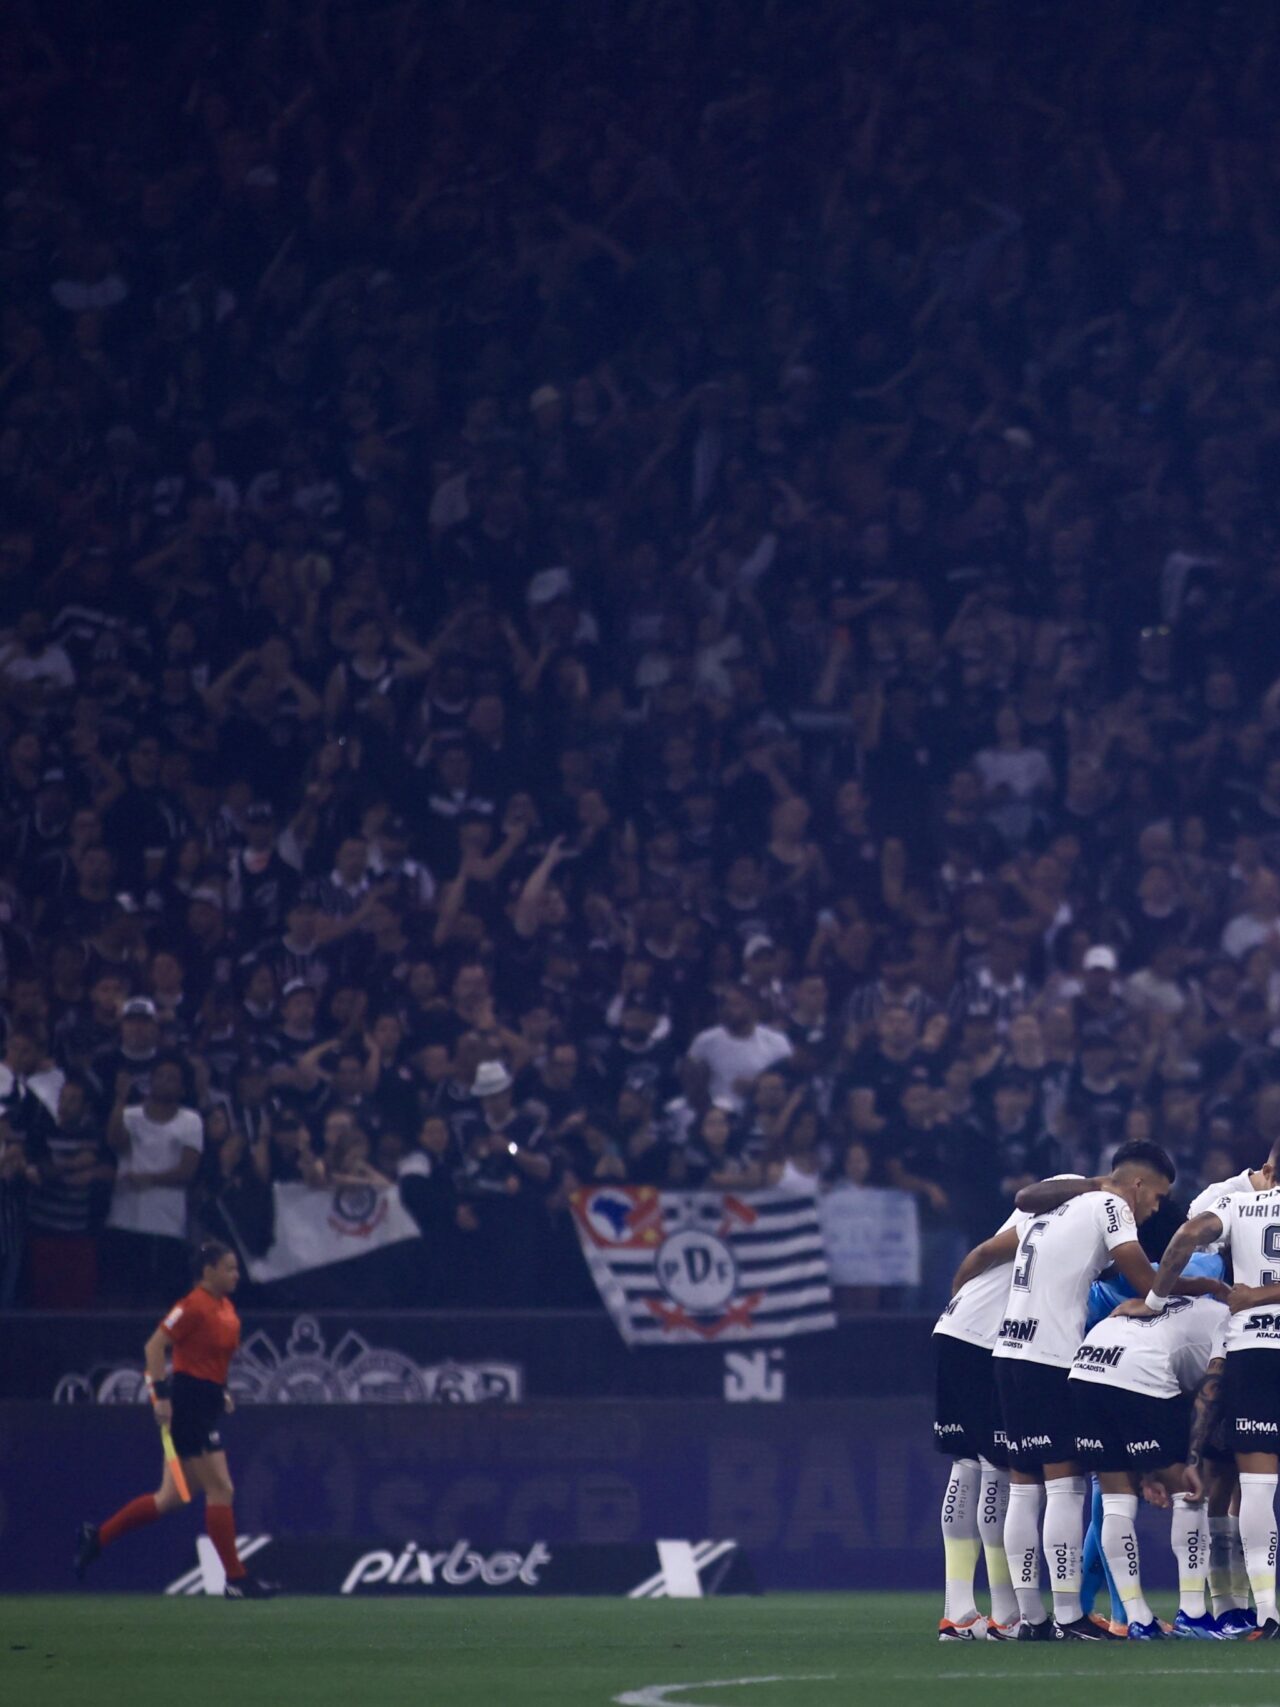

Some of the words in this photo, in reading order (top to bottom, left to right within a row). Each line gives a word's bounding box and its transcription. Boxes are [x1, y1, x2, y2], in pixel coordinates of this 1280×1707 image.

[1106, 1205, 1119, 1233] bmg
[1238, 1204, 1268, 1218] YURI
[1013, 1221, 1050, 1293] 5
[944, 1478, 960, 1523] TODOS
[984, 1480, 998, 1524] TODOS
[341, 1538, 550, 1594] pixbet
[1021, 1547, 1035, 1582] TODOS
[1053, 1542, 1067, 1580] TODOS
[1121, 1534, 1138, 1577] TODOS
[1187, 1529, 1199, 1569] TODOS
[1267, 1531, 1278, 1567] TODOS
